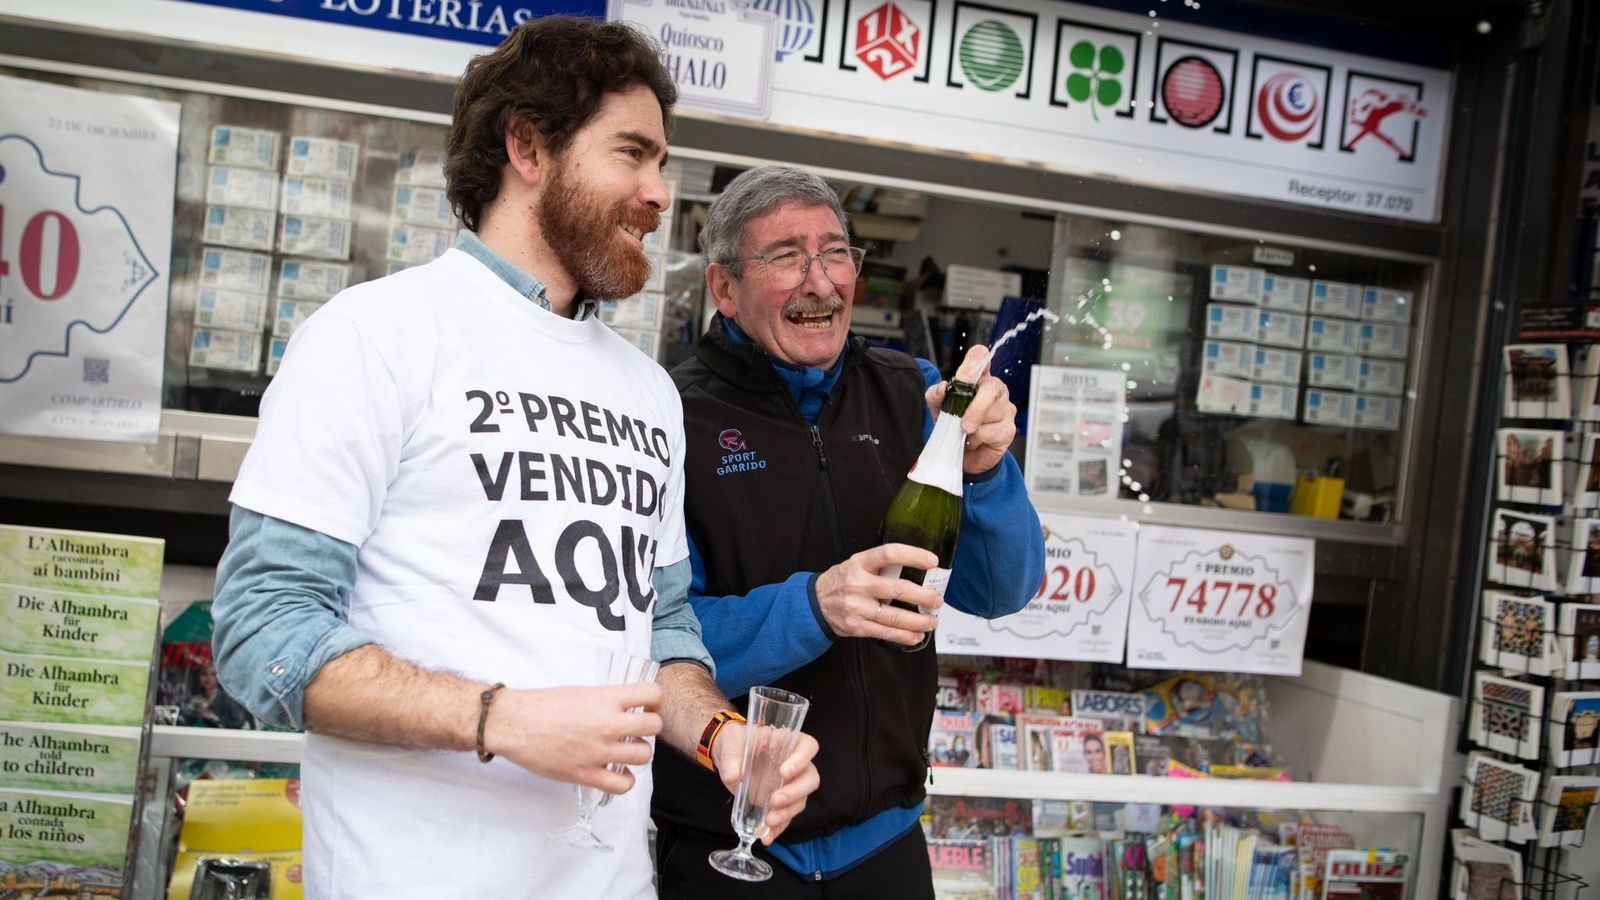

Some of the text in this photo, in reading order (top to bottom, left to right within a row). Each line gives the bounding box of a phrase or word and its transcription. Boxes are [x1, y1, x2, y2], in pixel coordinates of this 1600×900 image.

[661, 23, 724, 53] Quiosco
[664, 54, 727, 90] HALO
[1288, 179, 1361, 205] Receptor:
[517, 392, 671, 468] PREMIO
[716, 460, 767, 476] GARRIDO
[721, 451, 757, 465] SPORT
[33, 563, 121, 582] ai bambini
[472, 518, 657, 632] AQU
[1205, 562, 1255, 577] PREMIO
[18, 594, 129, 621] Die Alhambra
[1165, 577, 1278, 619] 74778
[63, 615, 80, 626] für
[43, 624, 99, 643] Kinder
[7, 662, 120, 686] Die Alhambra
[53, 681, 71, 693] für
[32, 690, 90, 709] Kinder
[1073, 690, 1144, 717] LABORES
[28, 734, 110, 755] Alhambra
[39, 750, 63, 761] told
[3, 759, 95, 778] to children
[13, 798, 96, 820] Alhambra
[18, 816, 65, 828] contada
[8, 824, 86, 844] los niños
[928, 844, 984, 871] UEBLE
